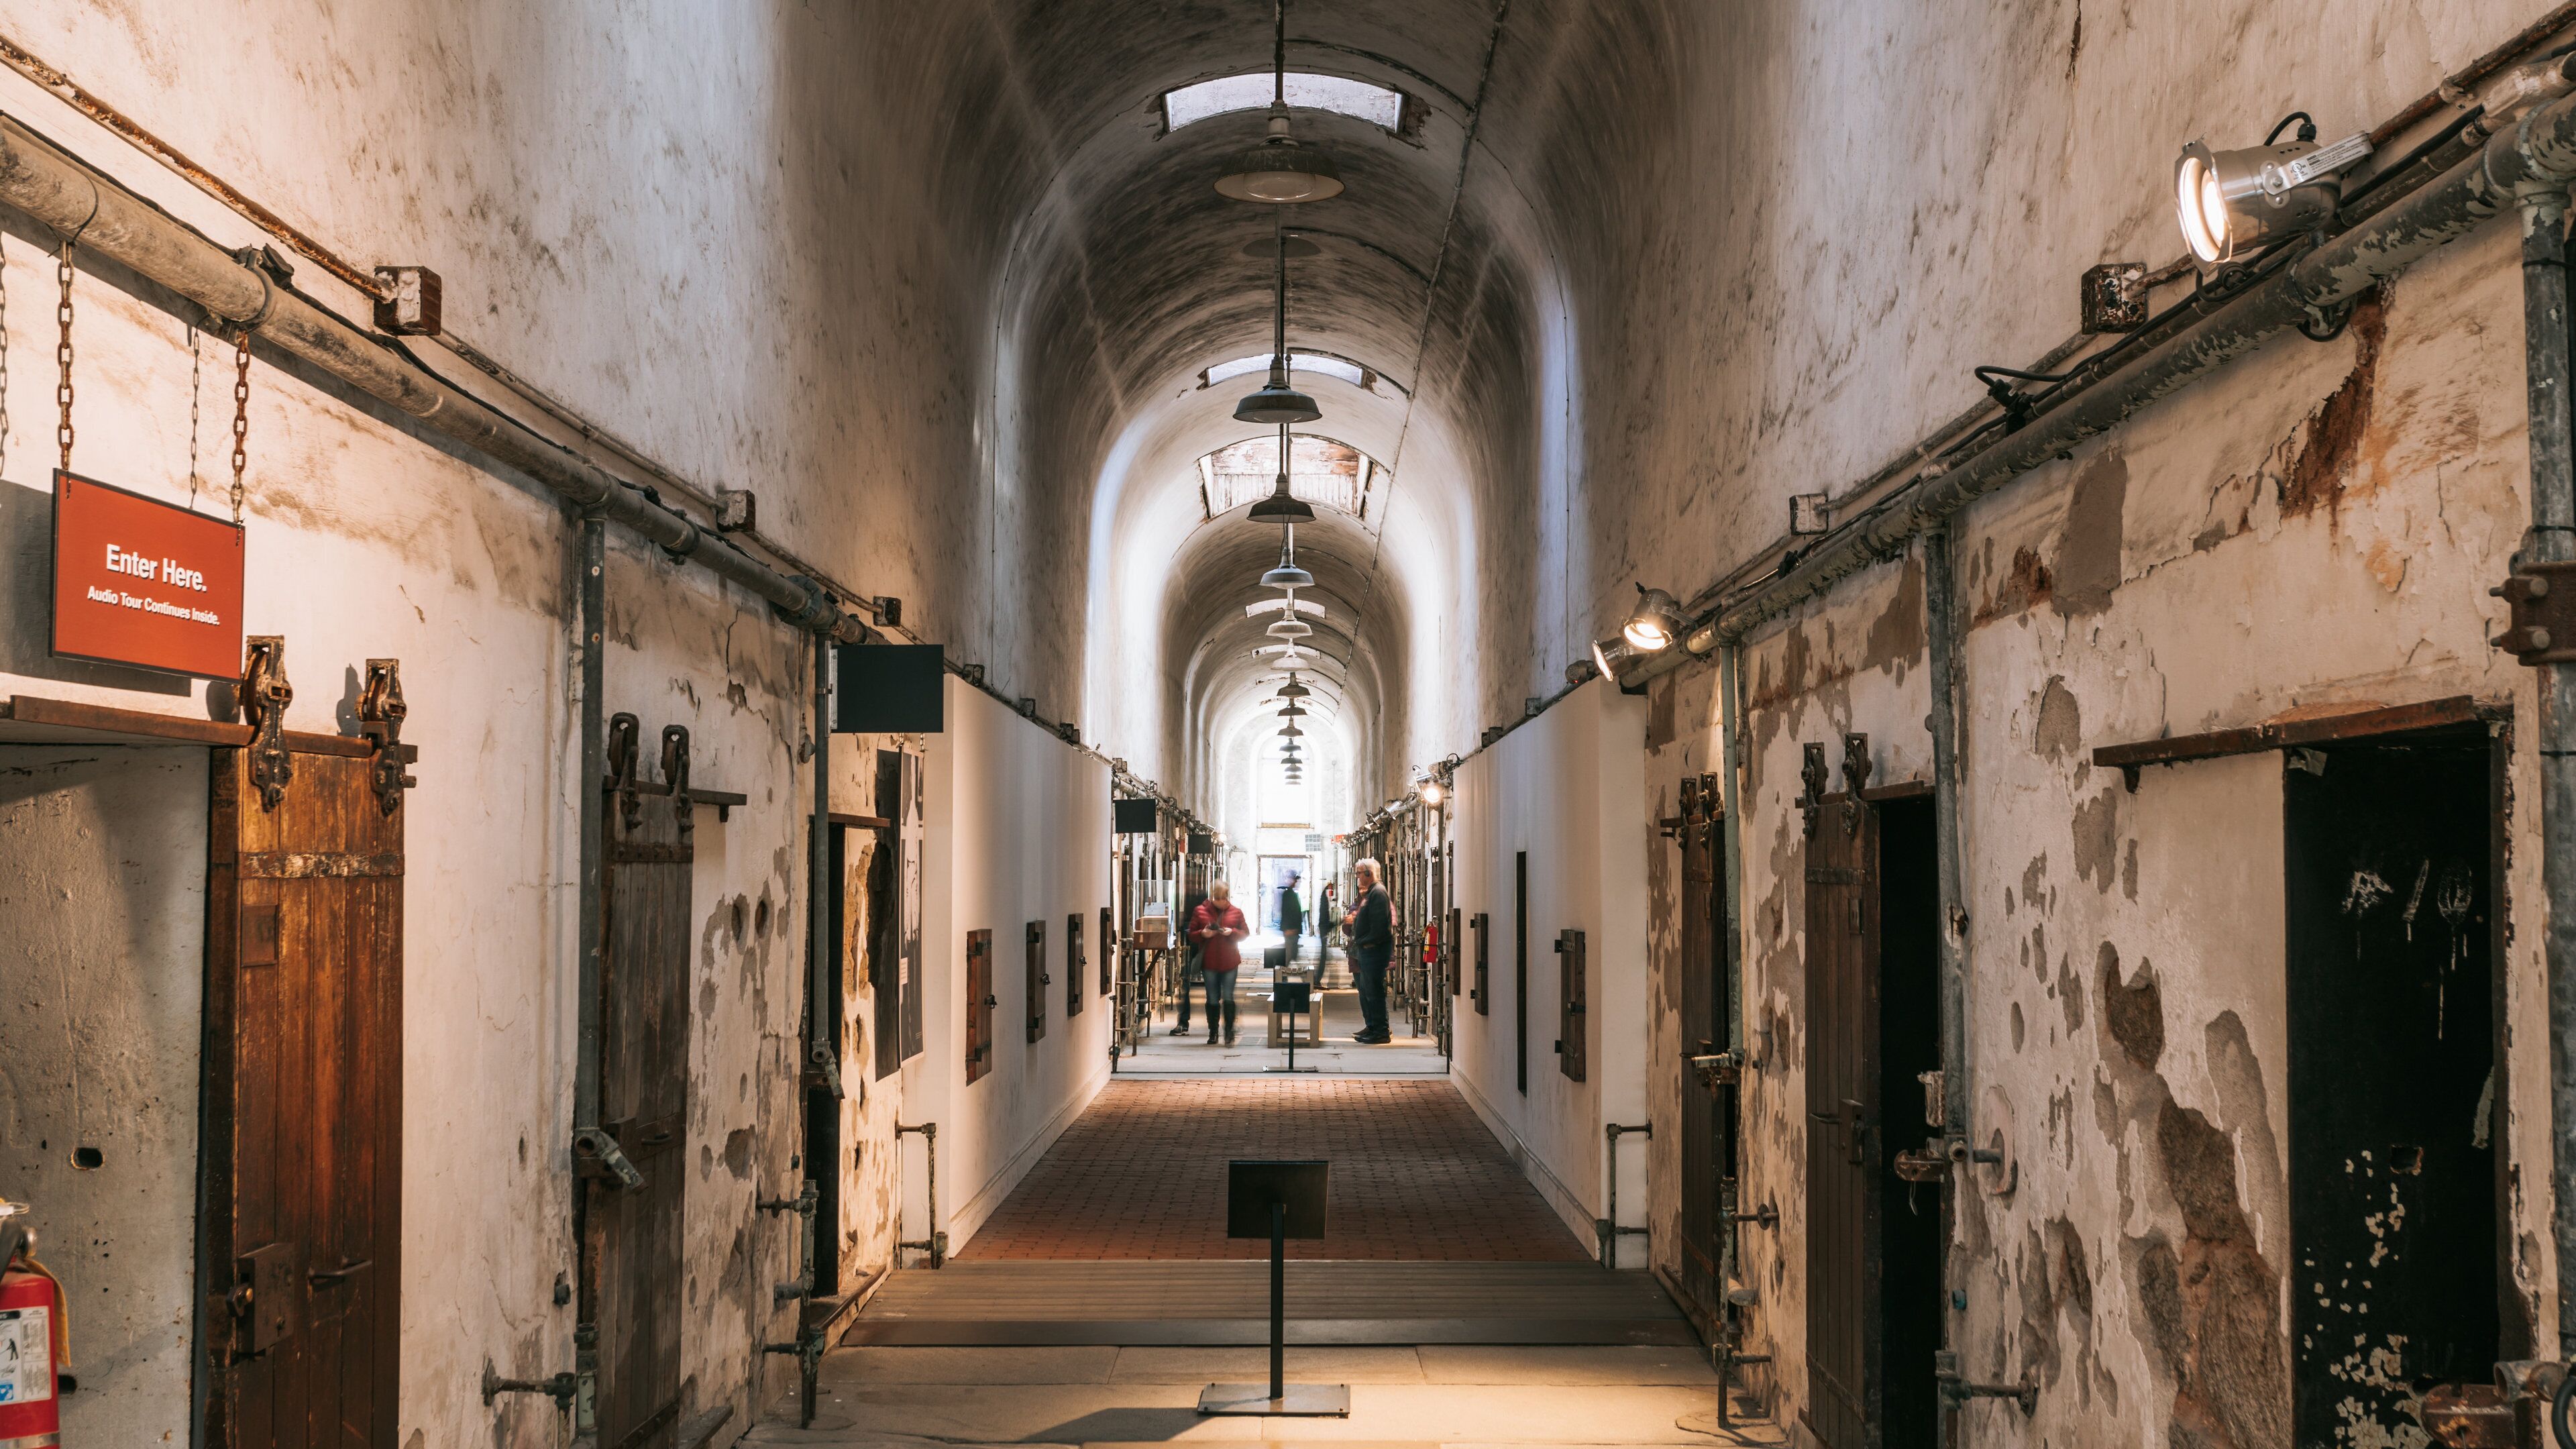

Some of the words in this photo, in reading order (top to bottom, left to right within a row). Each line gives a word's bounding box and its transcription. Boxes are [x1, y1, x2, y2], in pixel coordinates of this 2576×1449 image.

[106, 543, 158, 580] Enter
[162, 557, 207, 592] Here.
[87, 586, 118, 604] Audio
[119, 592, 143, 609] Tour
[144, 597, 191, 619] Continues
[192, 607, 220, 625] Inside.
